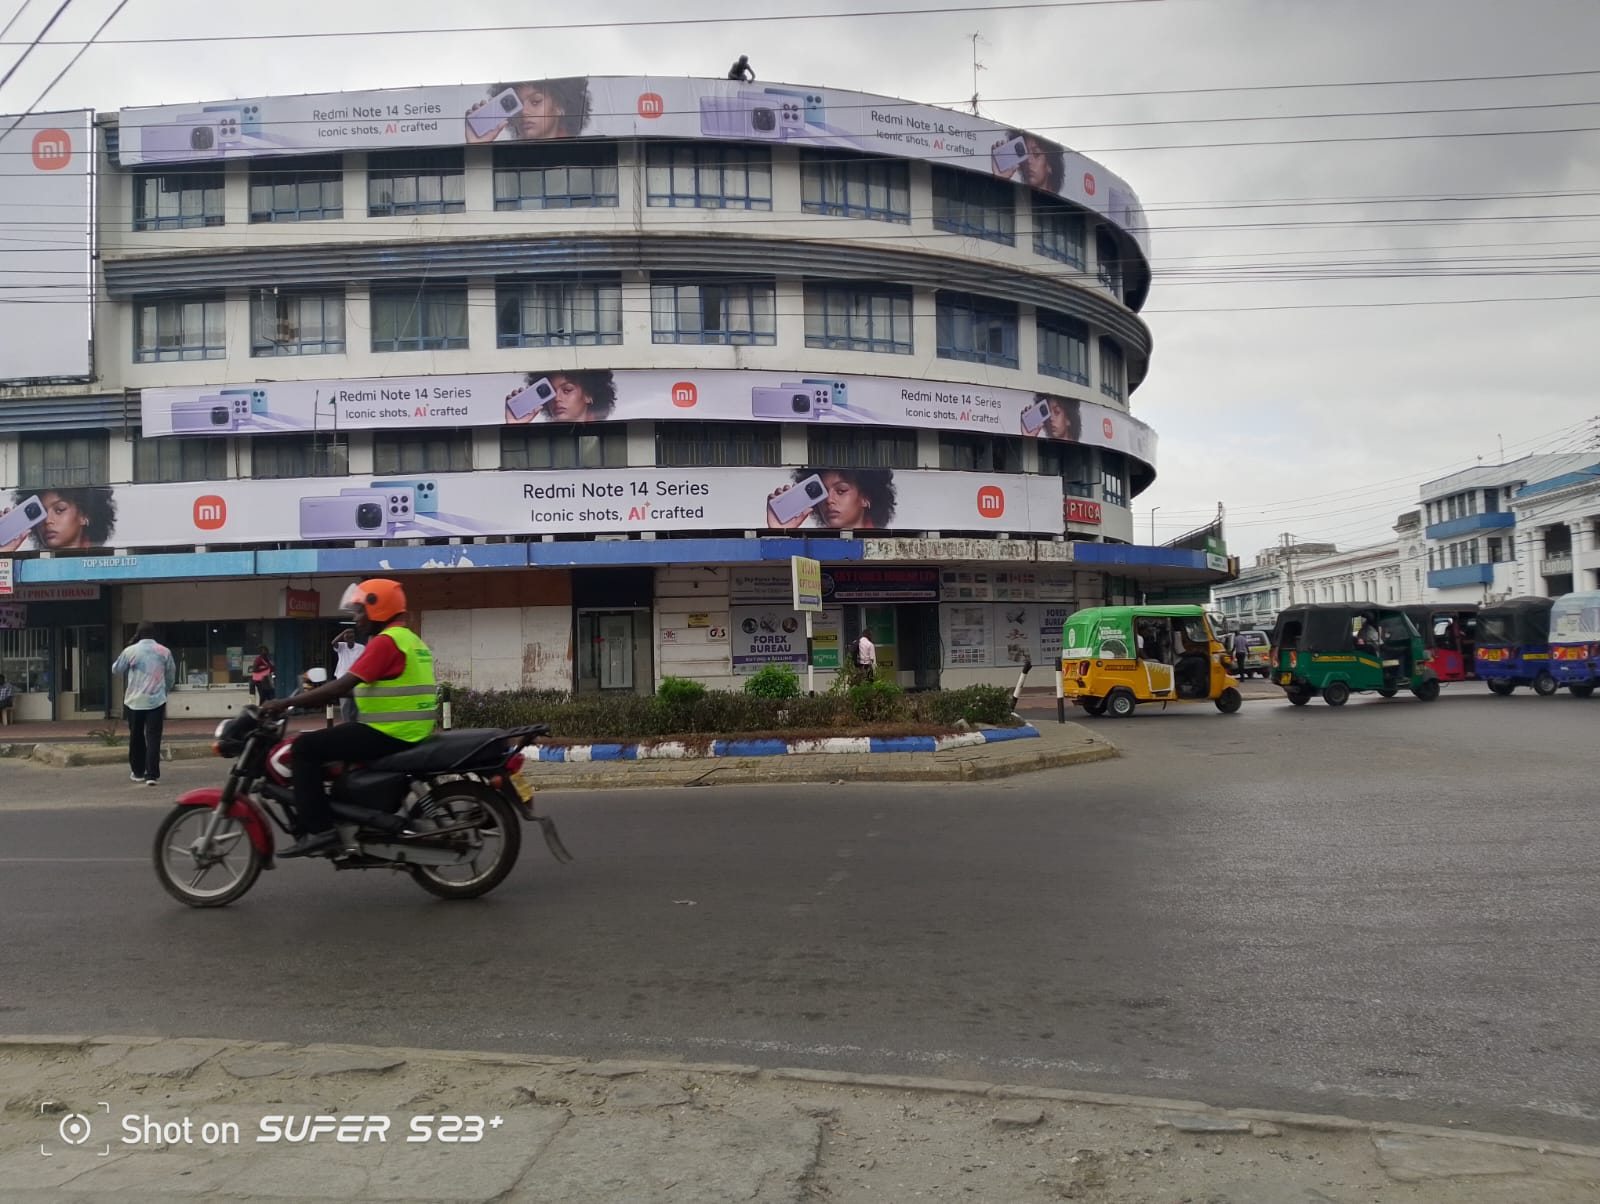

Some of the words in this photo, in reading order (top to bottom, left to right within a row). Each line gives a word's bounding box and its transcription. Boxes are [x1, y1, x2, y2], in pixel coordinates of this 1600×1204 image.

[313, 106, 348, 121] Redmi
[352, 106, 382, 118] Note
[386, 105, 399, 116] 14
[403, 102, 441, 116] Series
[318, 125, 348, 137] Iconic
[351, 124, 382, 136] shots,
[400, 121, 438, 133] crafted
[871, 110, 903, 126] Redmi
[906, 116, 931, 131] Note
[933, 122, 945, 134] 14
[947, 125, 977, 141] Series
[876, 129, 903, 142] Iconic
[906, 135, 931, 148] shots,
[946, 142, 975, 156] crafted
[339, 390, 377, 402] Redmi
[380, 389, 411, 401] Note
[415, 388, 428, 400] 14
[433, 387, 472, 399] Series
[901, 389, 932, 402] Redmi
[935, 392, 959, 404] Note
[961, 394, 972, 405] 14
[975, 396, 1002, 408] Series
[345, 409, 376, 419] Iconic
[379, 408, 411, 418] shots,
[430, 406, 468, 416] crafted
[905, 408, 931, 418] Iconic
[933, 409, 958, 421] shots,
[972, 413, 999, 424] crafted
[523, 483, 576, 499] Redmi
[582, 482, 624, 498] Note
[630, 481, 649, 497] 14
[656, 480, 710, 496] Series
[531, 508, 574, 522] Iconic
[579, 508, 623, 522] shots,
[650, 505, 704, 520] crafted
[81, 559, 97, 568] TOP
[753, 635, 787, 644] FOREX
[750, 644, 791, 653] BUREAU
